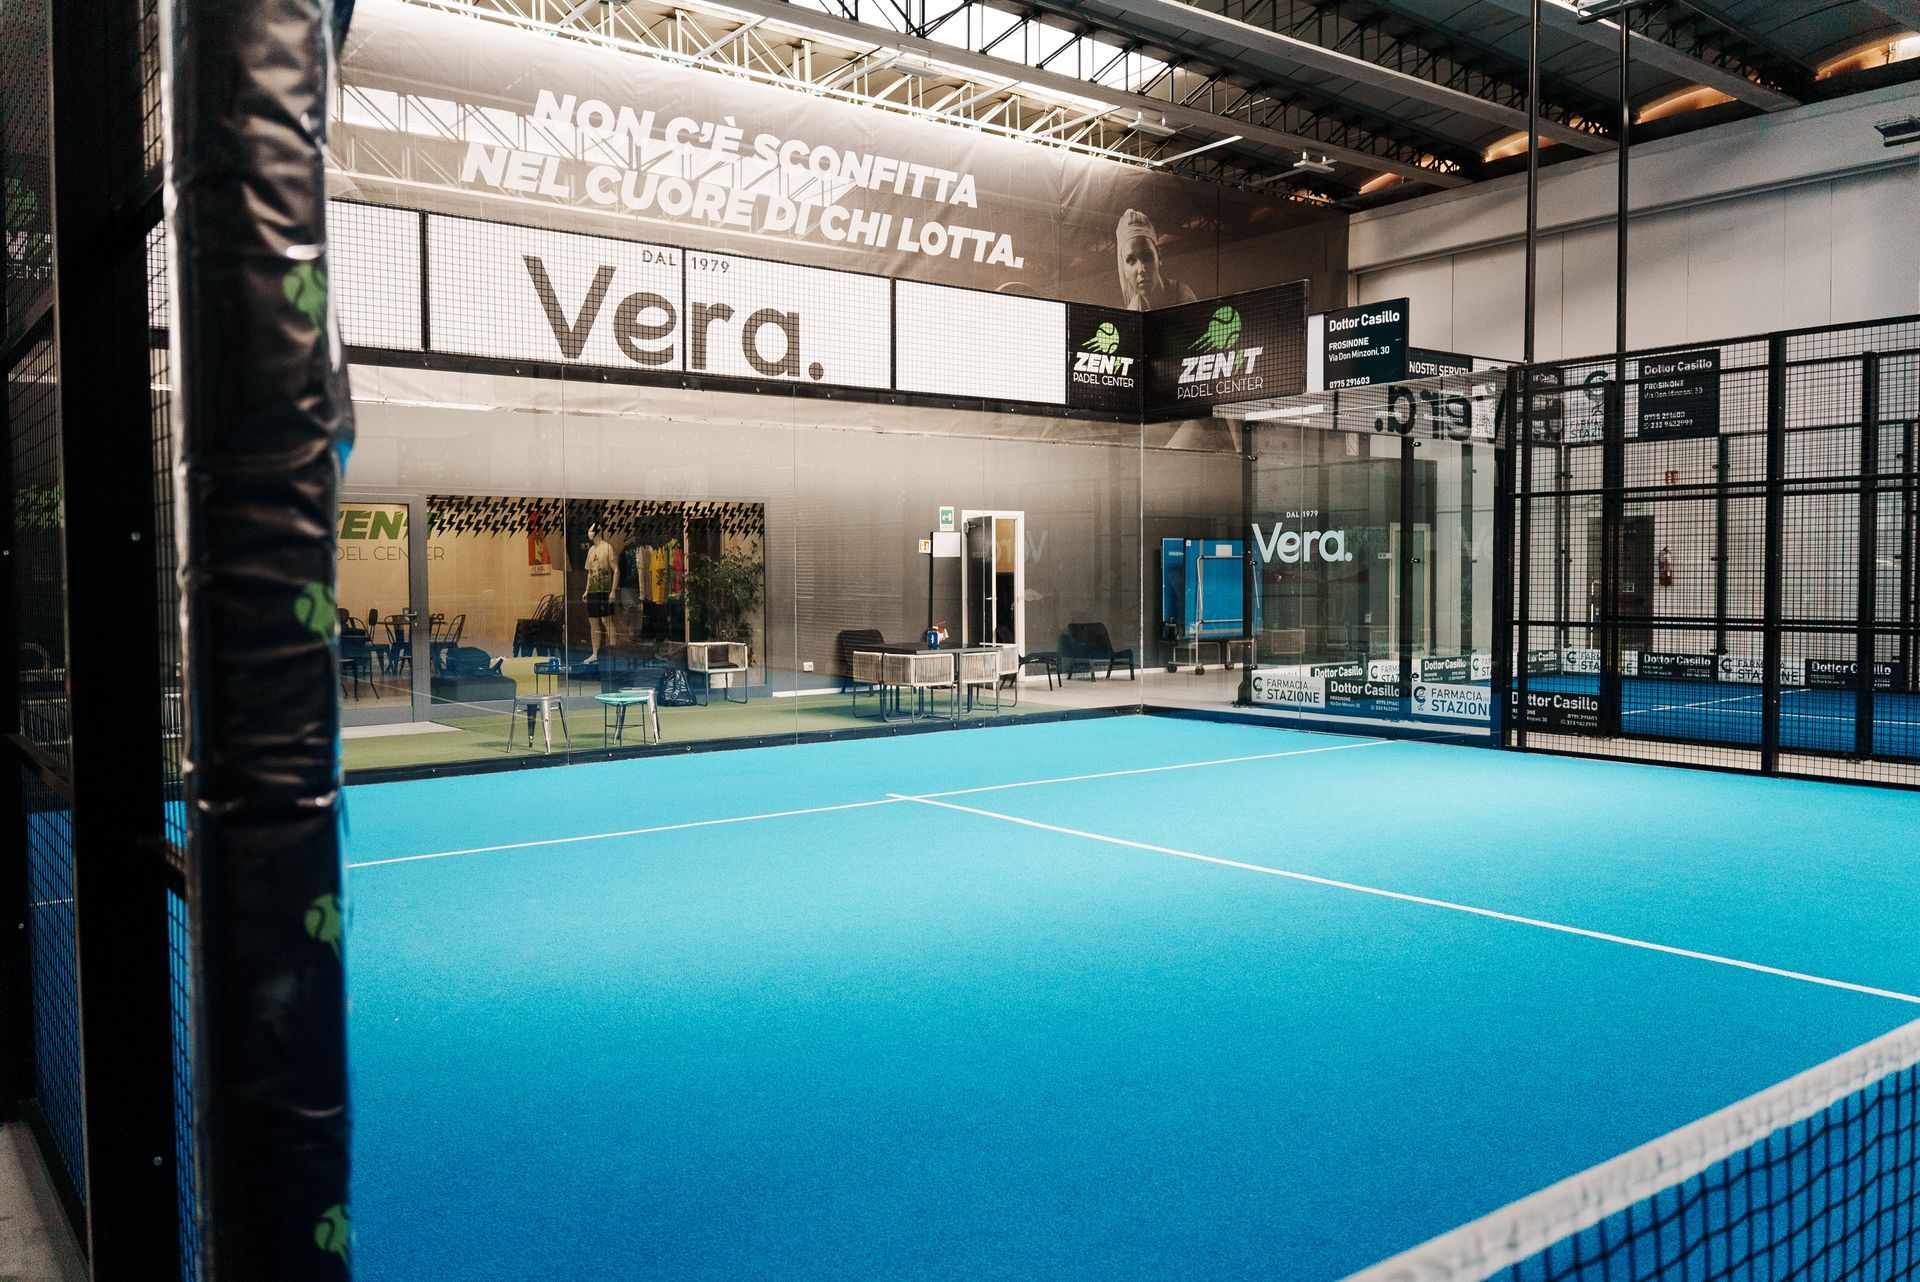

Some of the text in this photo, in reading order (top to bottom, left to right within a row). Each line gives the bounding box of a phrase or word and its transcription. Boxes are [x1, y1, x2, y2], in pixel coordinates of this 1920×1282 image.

[533, 89, 655, 149] NON
[752, 133, 978, 208] SCONFITTA
[461, 141, 1024, 269] NEL CUORE DI CHI LOTTA.
[642, 249, 730, 274] DAL 1979
[522, 254, 825, 382] Vera.
[1329, 310, 1401, 332] Dottor Casillo
[1329, 337, 1370, 351] FROSINONE
[1328, 354, 1339, 363] Via
[1339, 353, 1351, 361] Don
[1380, 346, 1390, 355] 30
[1409, 361, 1438, 376] NOSTRI
[1644, 359, 1713, 375] Dottor Casillo
[1073, 372, 1134, 388] PADEL CENTER
[1177, 376, 1264, 400] PADEL CENTER
[1329, 376, 1370, 389] 0775 291603
[1286, 510, 1319, 519] DAL 1979
[1251, 522, 1353, 563] Vera.
[372, 546, 445, 561] CENER
[1424, 658, 1467, 671] Dottor Casillo
[1644, 653, 1711, 666] Dottor Casillo
[1811, 661, 1849, 674] Dottor
[1315, 666, 1363, 679] Dottor Casillo
[1266, 678, 1309, 690] FARMACIA
[1330, 680, 1400, 697] Dottor Casillo
[1266, 688, 1320, 704] STAZIONE
[1431, 687, 1483, 701] FARMACIA
[1511, 691, 1598, 711] Dttor Casillo
